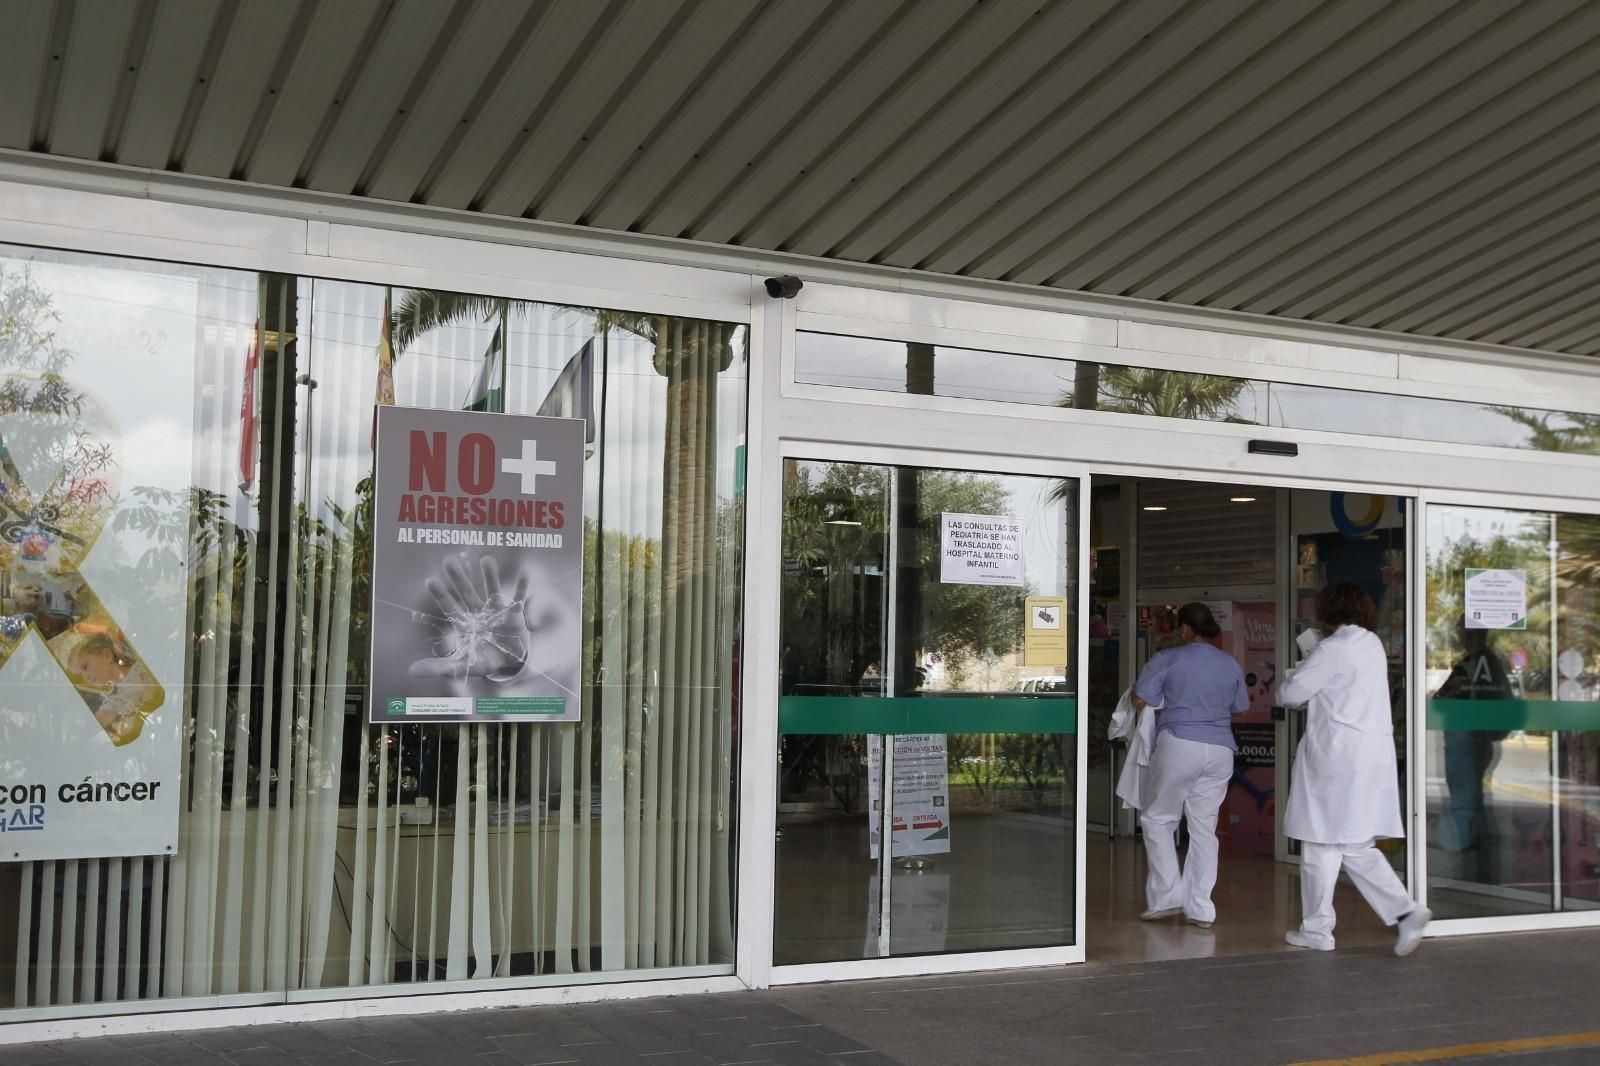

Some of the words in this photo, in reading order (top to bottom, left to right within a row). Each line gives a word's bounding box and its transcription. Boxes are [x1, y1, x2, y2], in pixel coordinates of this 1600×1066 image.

[397, 494, 565, 530] AGRESIONES
[948, 521, 963, 529] LAS
[964, 522, 1008, 532] CONSULTAS
[1009, 525, 1020, 533] DE
[397, 527, 415, 543] AL
[416, 528, 485, 546] PERSONAL
[487, 531, 503, 546] DE
[505, 532, 563, 549] SANIDAD
[990, 533, 1000, 541] SE
[1001, 534, 1017, 542] HAN
[953, 540, 1003, 550] TRASLADADO
[1003, 543, 1014, 551] AL
[946, 549, 983, 559] HOSPITAL
[984, 552, 1020, 561] MATERNO
[966, 560, 1000, 569] INFANTIL
[58, 776, 161, 804] cáncer
[912, 814, 938, 822] ENTRADA
